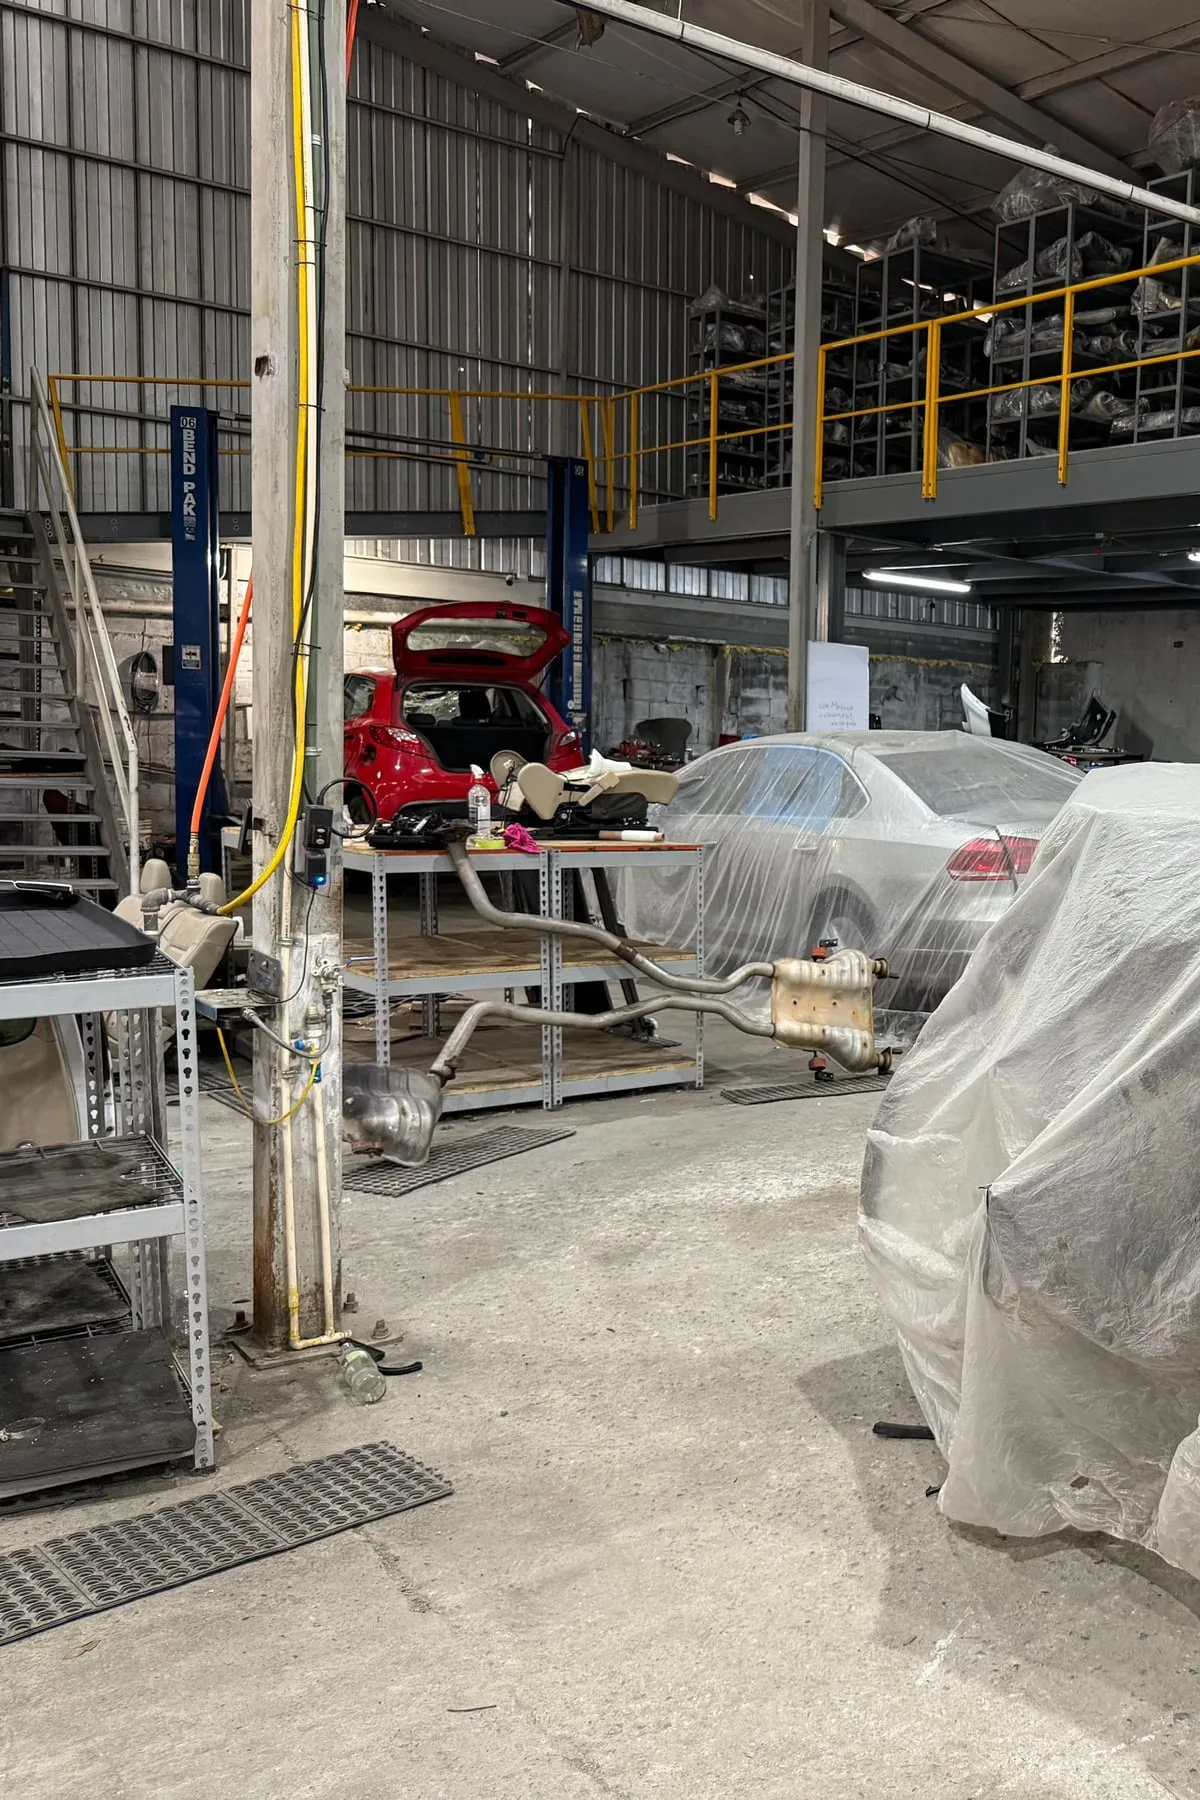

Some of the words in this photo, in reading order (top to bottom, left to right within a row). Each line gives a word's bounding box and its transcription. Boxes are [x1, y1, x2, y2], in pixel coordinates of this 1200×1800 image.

[181, 417, 196, 428] 06
[182, 429, 196, 475] BEND
[183, 482, 196, 516] PAK
